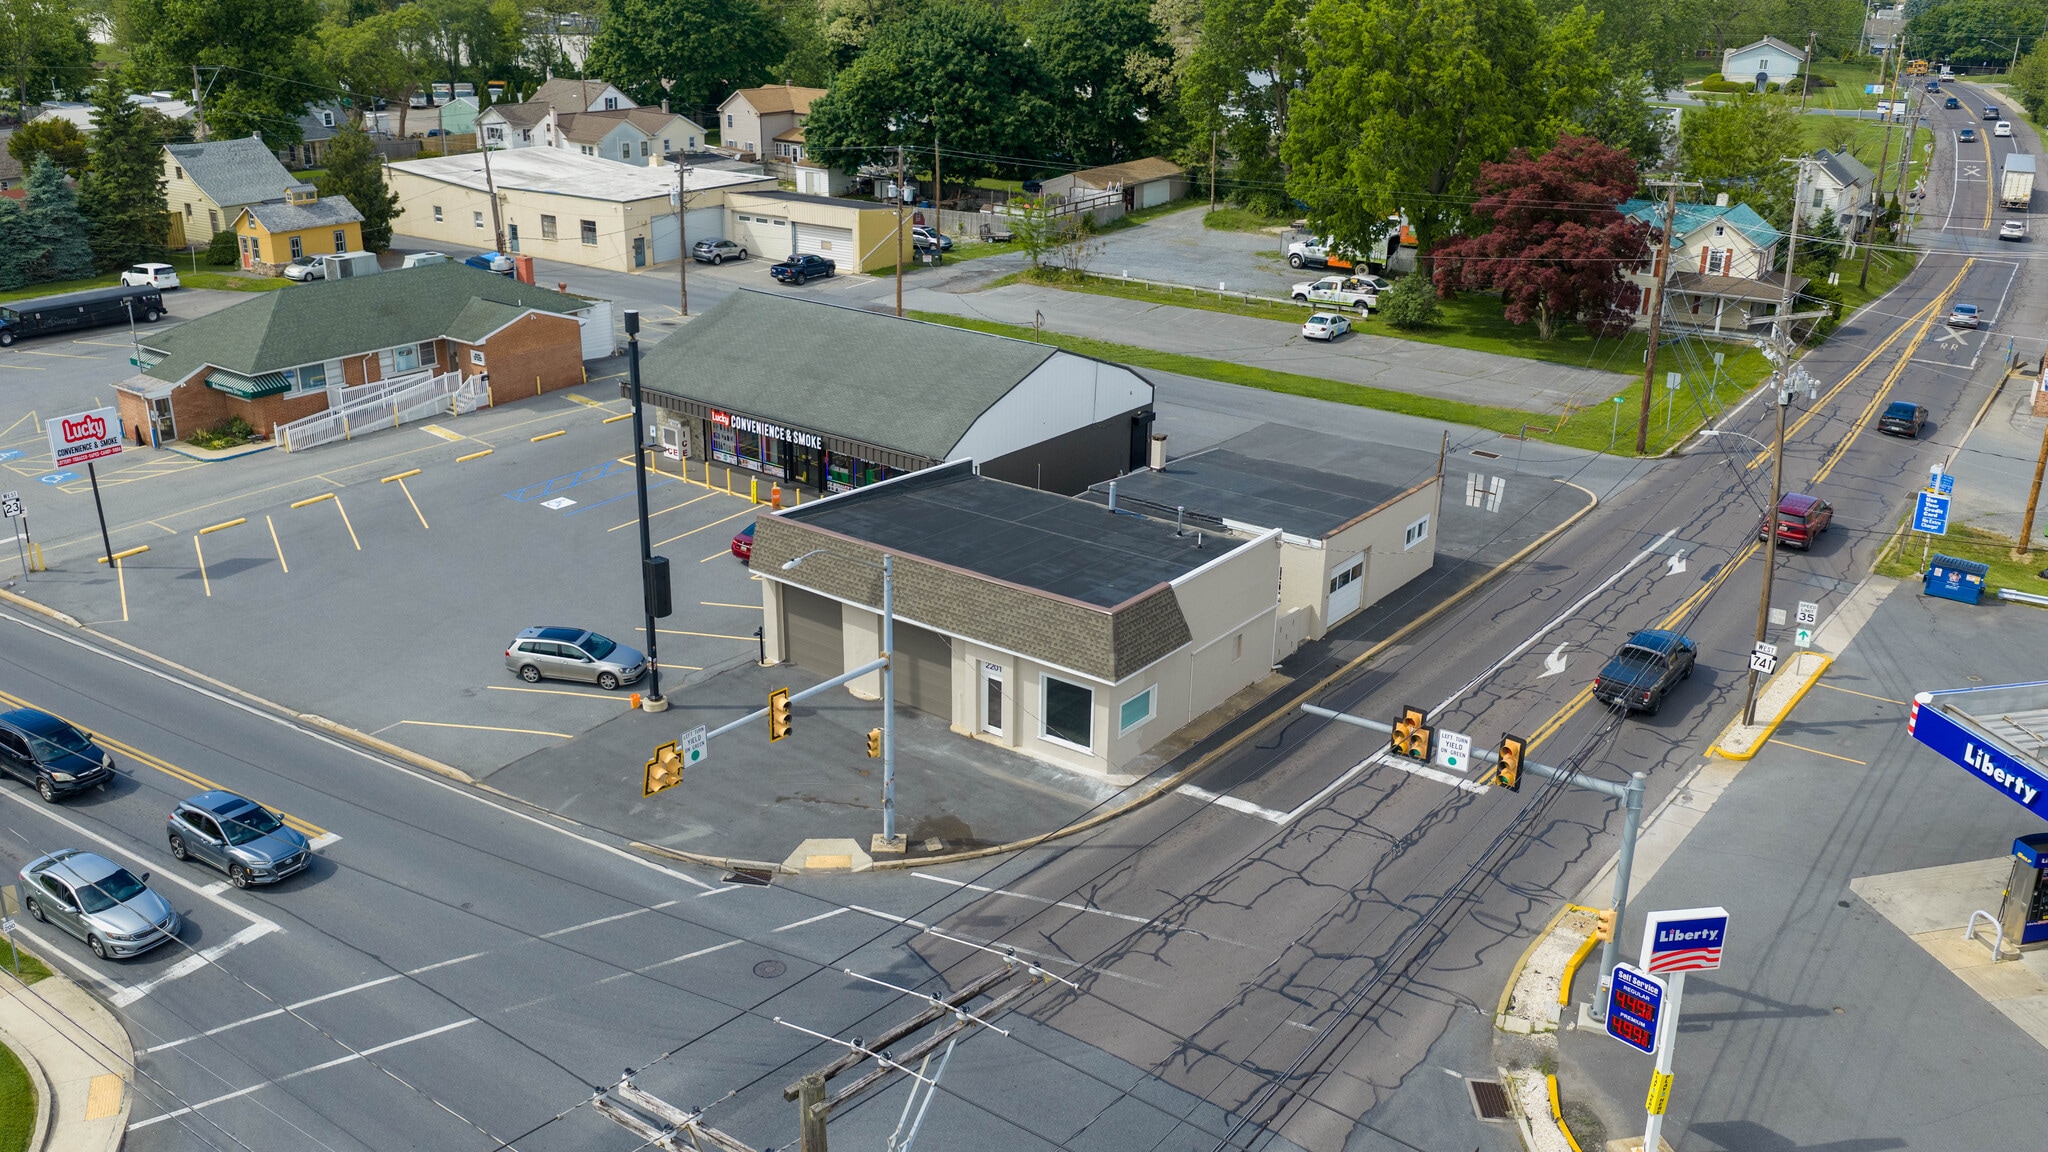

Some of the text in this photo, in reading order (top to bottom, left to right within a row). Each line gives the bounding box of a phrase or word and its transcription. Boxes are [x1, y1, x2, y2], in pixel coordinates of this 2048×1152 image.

[64, 418, 104, 440] Lucky
[711, 411, 822, 450] Lucky CONVENIENCE & SMOKE
[57, 443, 93, 457] CONVENIENCE
[101, 437, 118, 447] SMOKE
[5, 502, 19, 513] 23
[1799, 612, 1814, 622] 35
[1758, 644, 1774, 653] WEST
[985, 662, 1002, 672] 2201
[1753, 656, 1772, 670] 741
[683, 732, 692, 740] LEFT
[688, 735, 701, 745] YIELD
[692, 741, 704, 750] GREEN
[1446, 741, 1462, 751] YIELD
[1450, 750, 1465, 758] GREEN
[1964, 742, 2037, 804] Liberty
[1659, 929, 1719, 942] Liberty
[1618, 971, 1658, 995] Self Service
[1623, 985, 1650, 1001] REGULAR
[1620, 1012, 1646, 1027] PREMIUM
